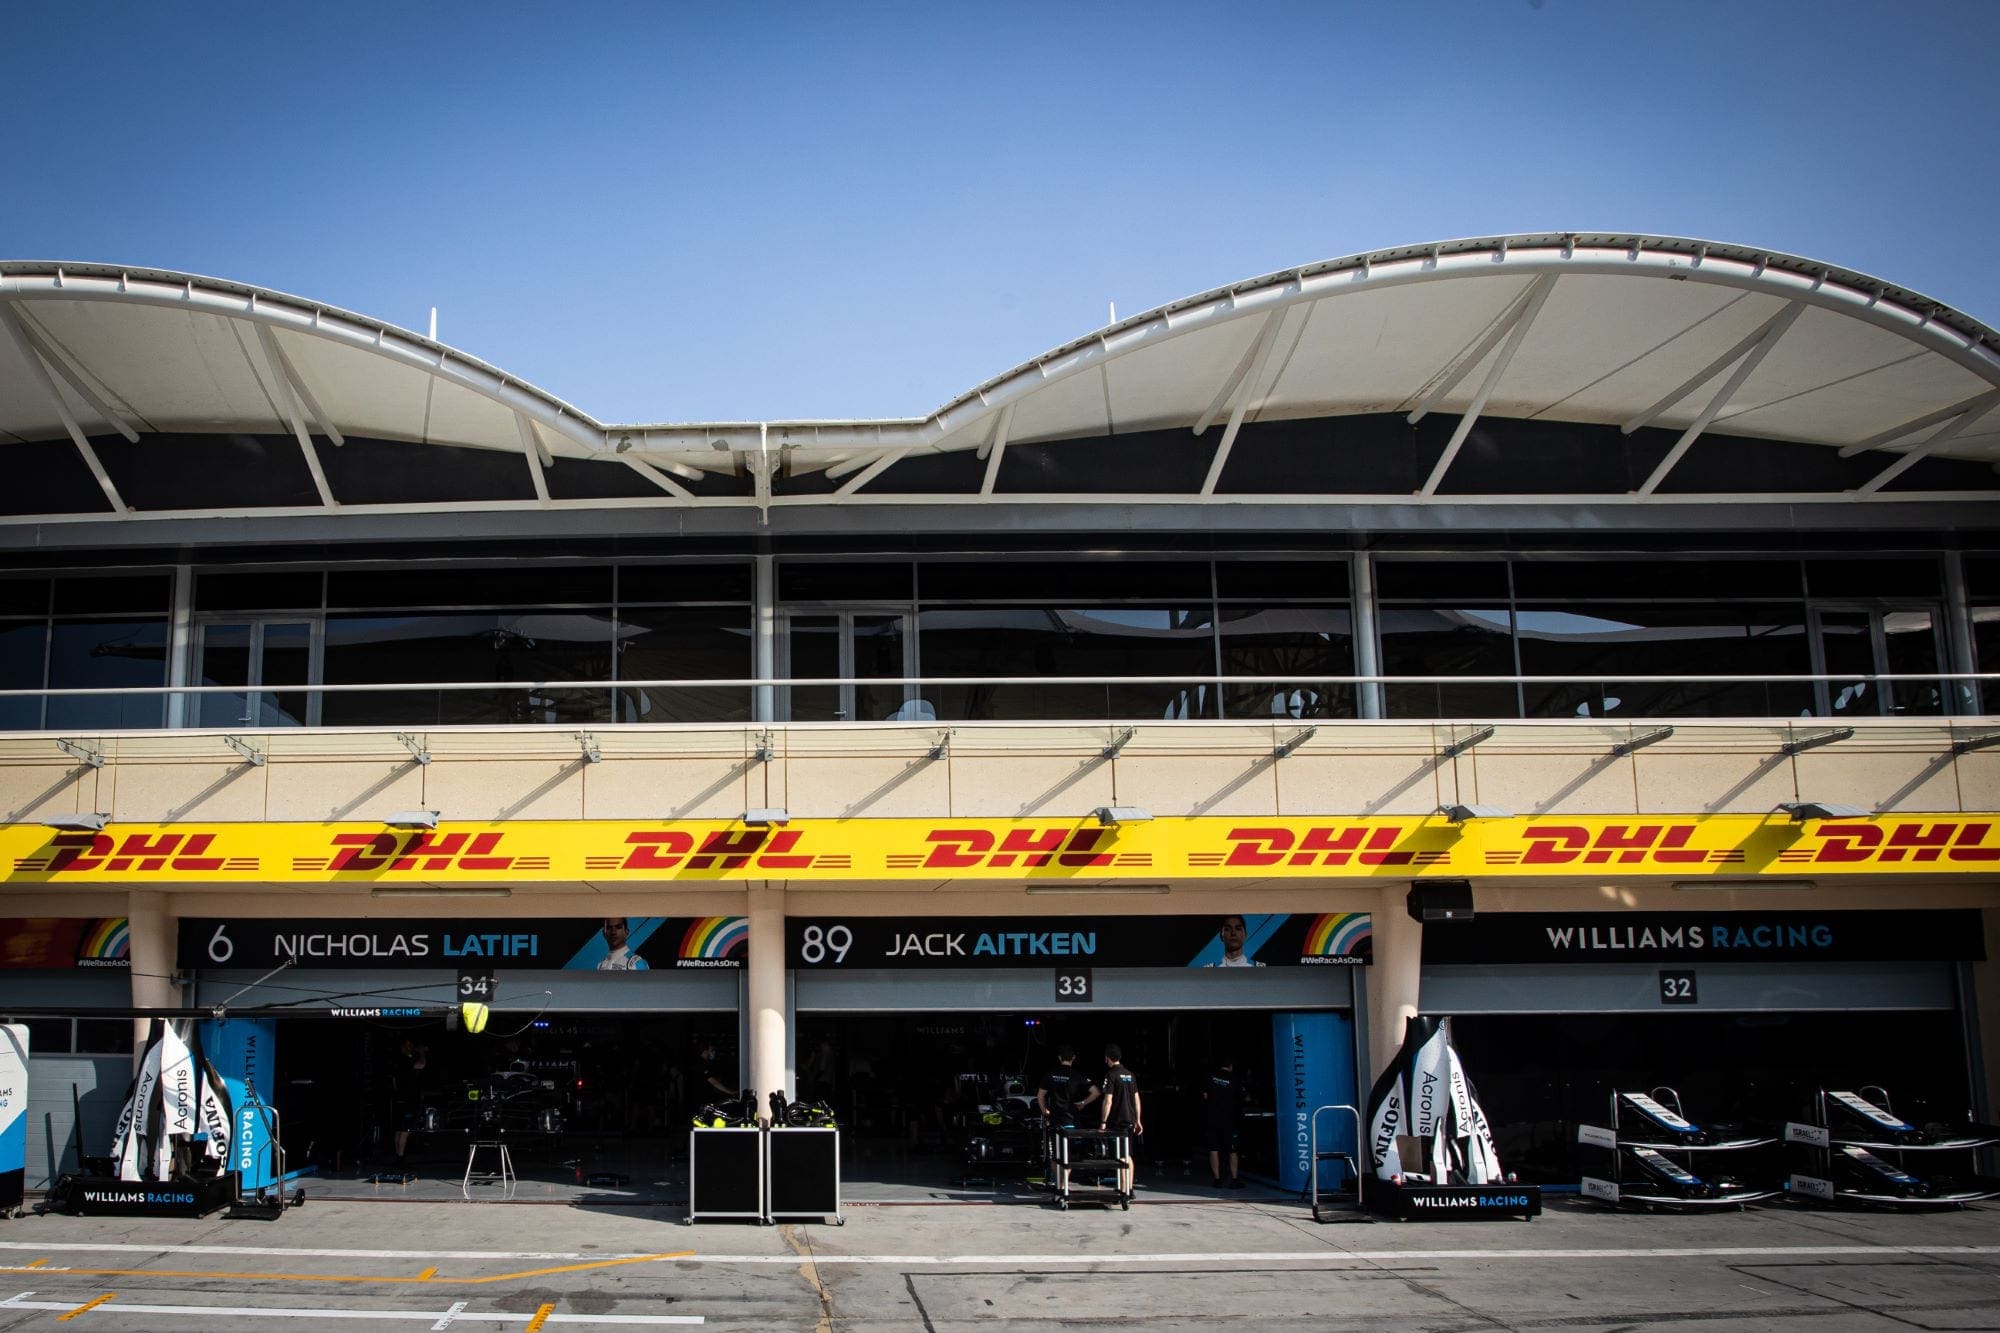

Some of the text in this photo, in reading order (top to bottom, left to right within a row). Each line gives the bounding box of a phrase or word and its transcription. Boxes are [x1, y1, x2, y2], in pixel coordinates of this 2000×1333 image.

[46, 834, 227, 871] DHL
[327, 833, 515, 870] DHL
[621, 831, 815, 869] DHL
[923, 829, 1117, 867] DHL
[1225, 827, 1416, 865] DHL
[1521, 825, 1710, 864] DHL
[1815, 824, 2000, 862] DHL
[208, 924, 234, 963] 6
[274, 934, 539, 957] NICHOLAS LATIFI
[801, 925, 854, 963] 89
[885, 931, 1097, 956] JACK AITKEN
[1546, 924, 1833, 950] WILLIAMS RACING
[78, 959, 131, 968] #WeRaceAsOn
[676, 959, 740, 968] #WeRaceAsOne
[1300, 955, 1364, 966] #WeRaceAsOne
[460, 975, 488, 994] 34
[1058, 975, 1087, 995] 33
[1663, 978, 1692, 997] 32
[331, 1007, 422, 1018] WILLIAMS RACING
[133, 1071, 153, 1132] Acronis
[173, 1069, 188, 1129] Acronis
[1293, 1033, 1309, 1172] WILLIAMS RACING
[1419, 1071, 1438, 1134] Acronis
[1451, 1072, 1470, 1132] Acronis
[205, 1096, 227, 1168] SOFINA
[241, 1111, 254, 1169] RACING
[1374, 1096, 1400, 1168] SOFINA
[84, 1191, 195, 1204] WILLIAMS RACING
[1413, 1195, 1529, 1208] WILLIAMS RACING
